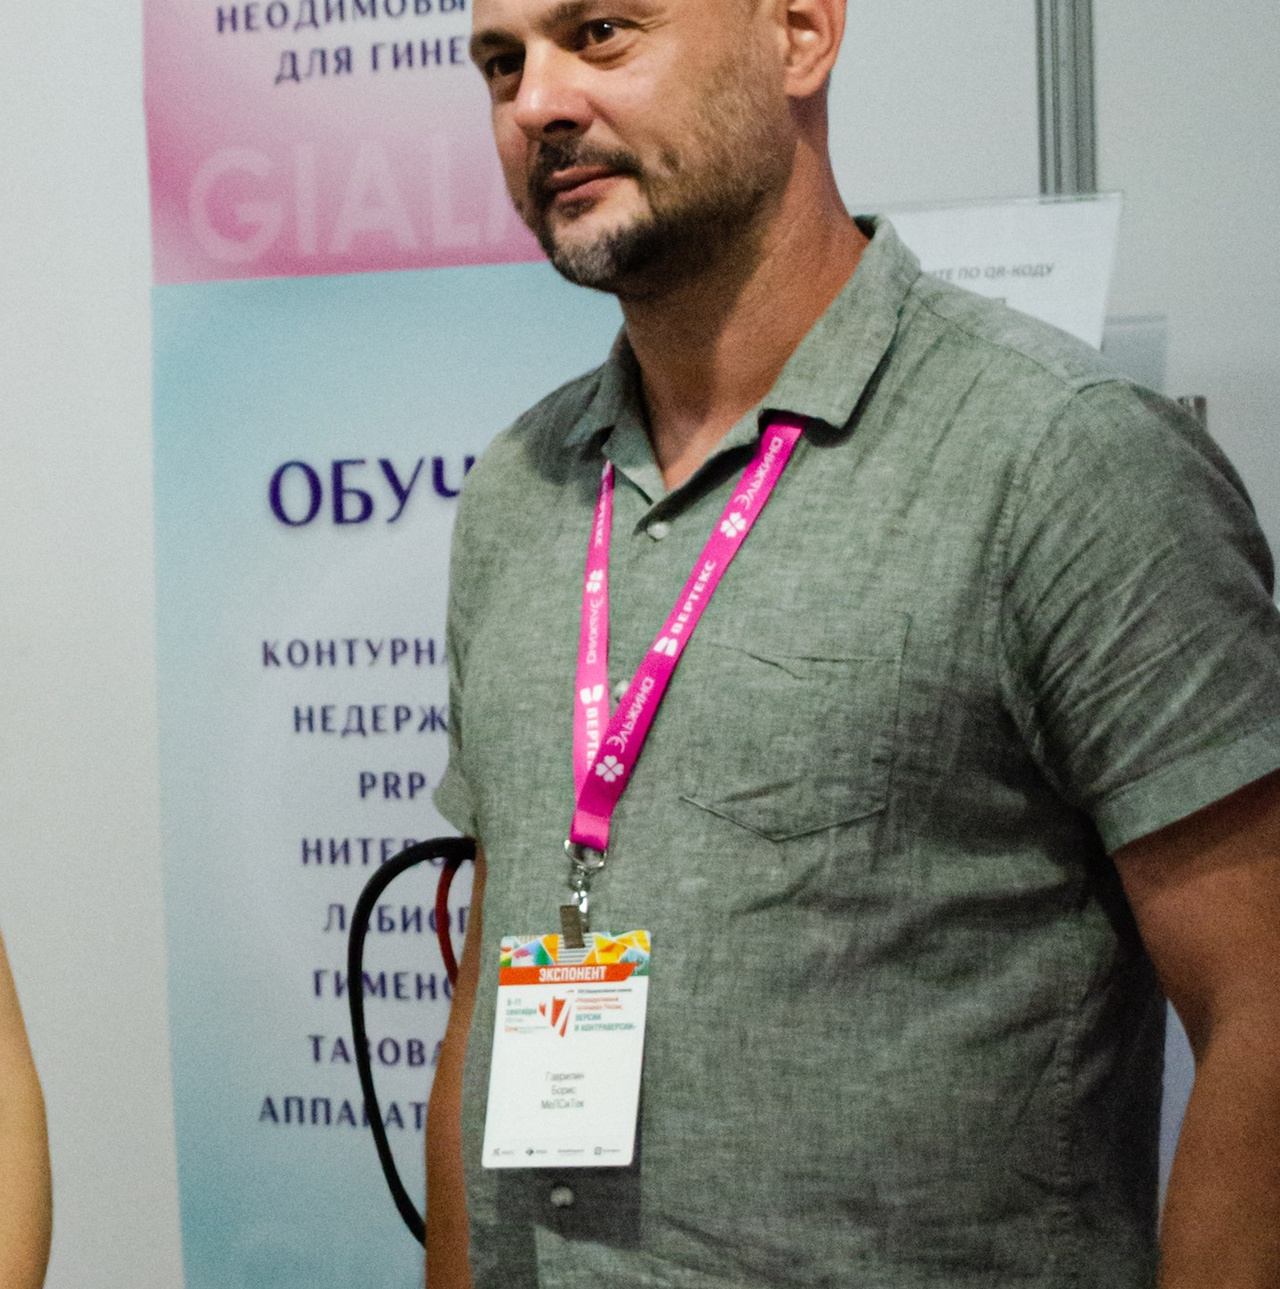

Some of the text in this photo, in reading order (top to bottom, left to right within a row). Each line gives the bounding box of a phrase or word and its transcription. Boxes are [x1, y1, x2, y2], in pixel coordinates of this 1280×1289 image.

[275, 37, 471, 85] ДЛЯ ГИНЕ
[670, 560, 717, 635] ВЕРТЕКС
[293, 704, 449, 738] НЕДЕРЖ
[359, 771, 426, 800] PRP
[538, 966, 607, 983] ЭКСПОНЕНТ
[308, 1034, 444, 1067] ТАОВ
[259, 1096, 428, 1130] АППААТ
